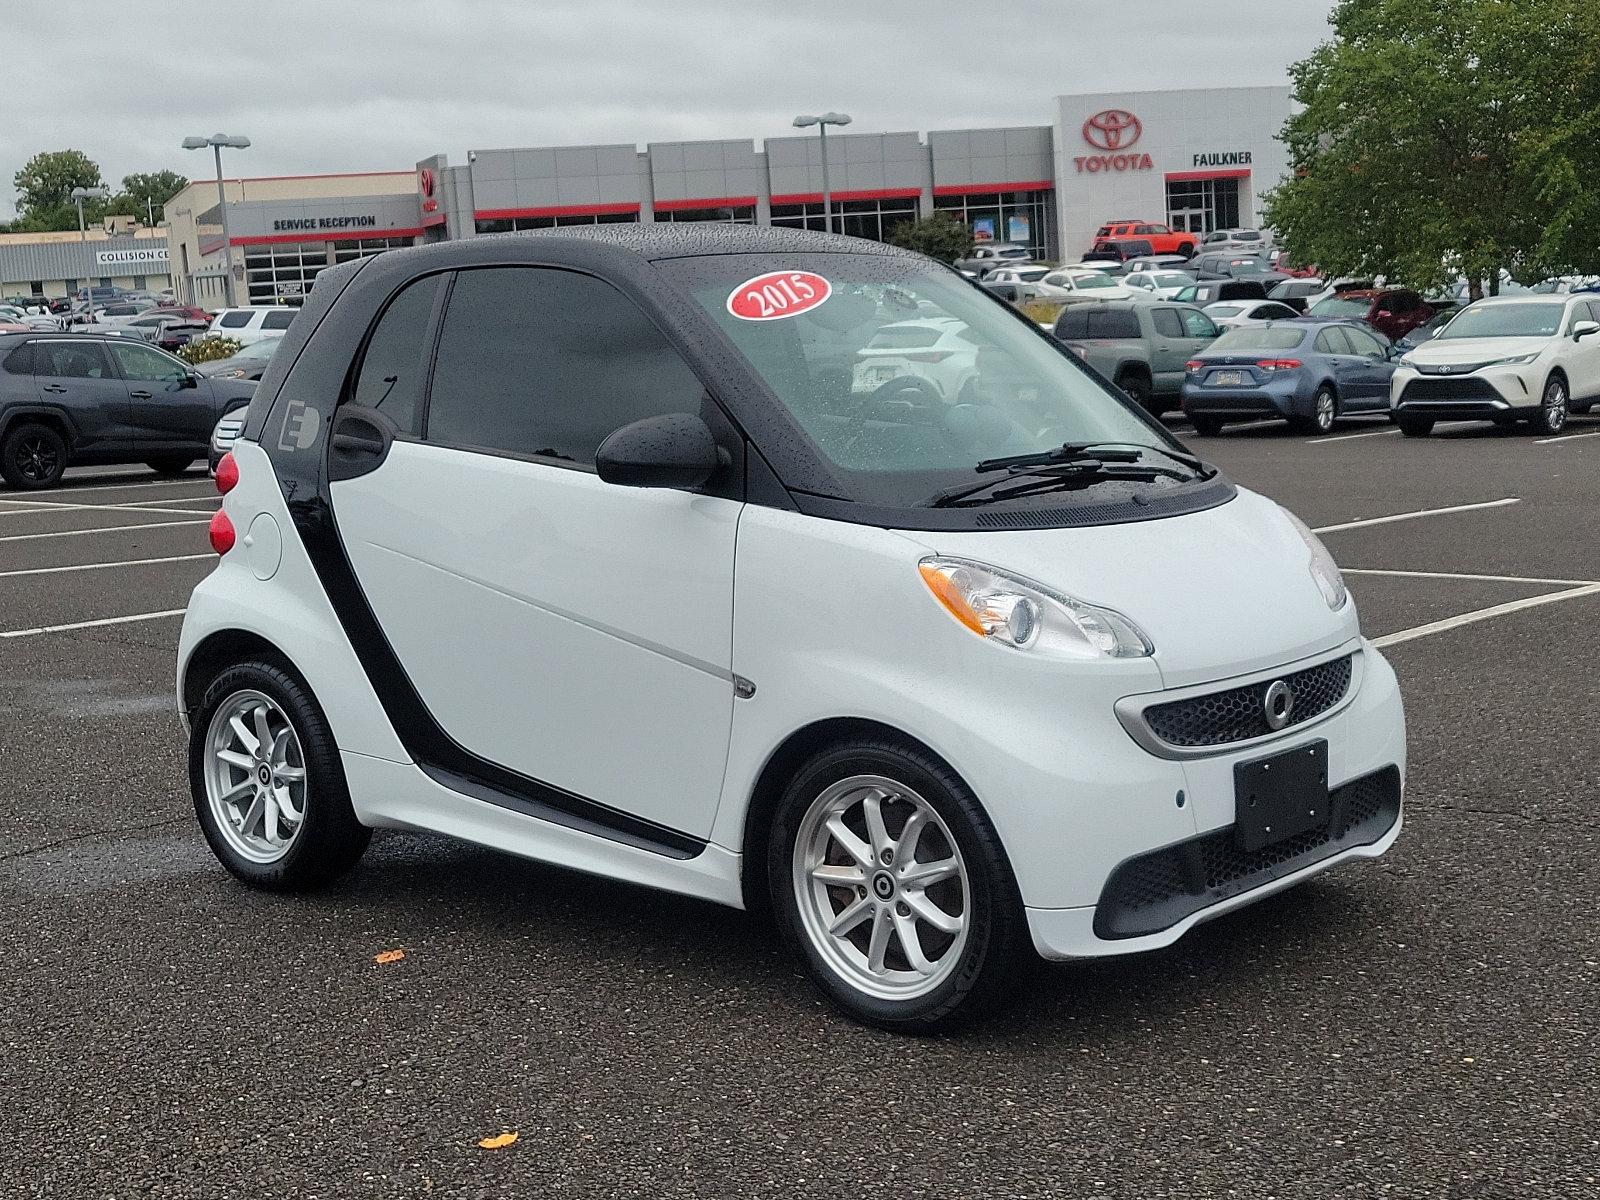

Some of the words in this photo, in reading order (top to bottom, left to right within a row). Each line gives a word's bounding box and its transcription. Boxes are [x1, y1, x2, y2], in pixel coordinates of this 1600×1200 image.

[1074, 153, 1154, 174] TOYOTA
[1193, 151, 1252, 167] FAULKNER
[274, 218, 317, 231] SERVICE
[319, 215, 376, 228] RECEPTION
[100, 251, 155, 262] COLLISION
[747, 274, 815, 317] 2015
